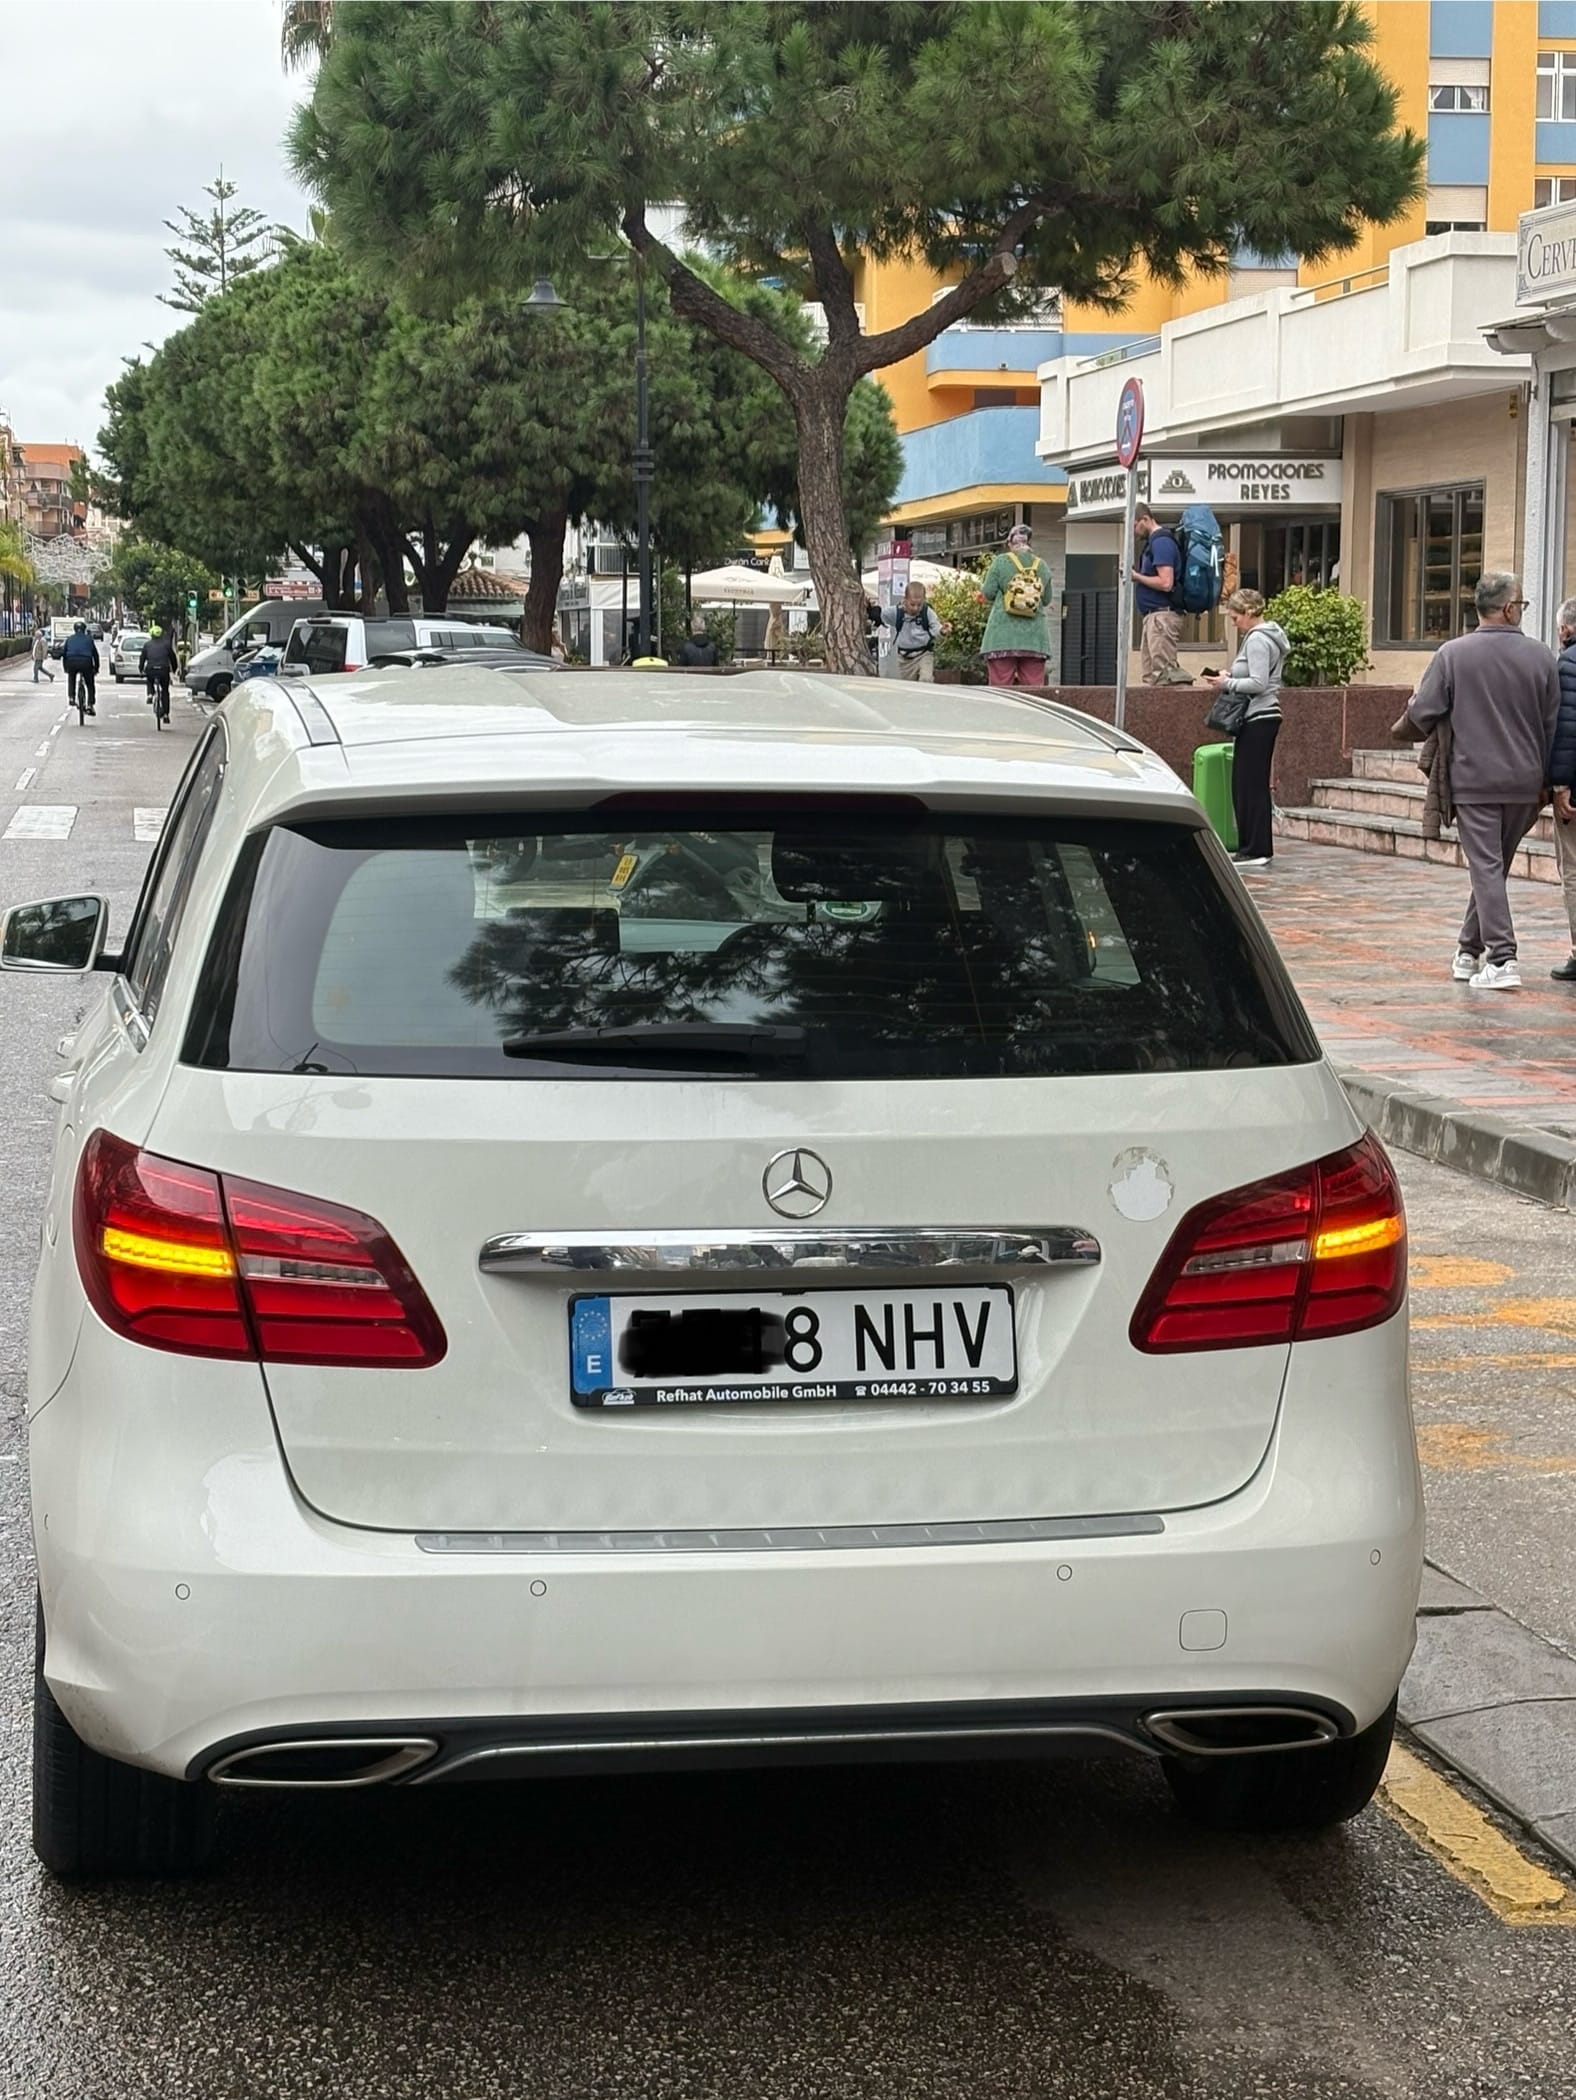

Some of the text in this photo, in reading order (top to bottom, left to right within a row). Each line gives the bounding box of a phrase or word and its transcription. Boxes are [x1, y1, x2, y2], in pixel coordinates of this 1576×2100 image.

[1208, 463, 1325, 480] PROMOCIONES
[1240, 484, 1290, 500] REYES
[854, 1301, 991, 1372] NHV
[587, 1355, 601, 1374] E
[656, 1389, 702, 1403] Refhat
[706, 1386, 789, 1401] Automobile
[792, 1384, 837, 1398] GmbH
[871, 1382, 916, 1396] 04442
[928, 1382, 947, 1394] 70
[950, 1381, 968, 1394] 34
[972, 1380, 990, 1393] 55
